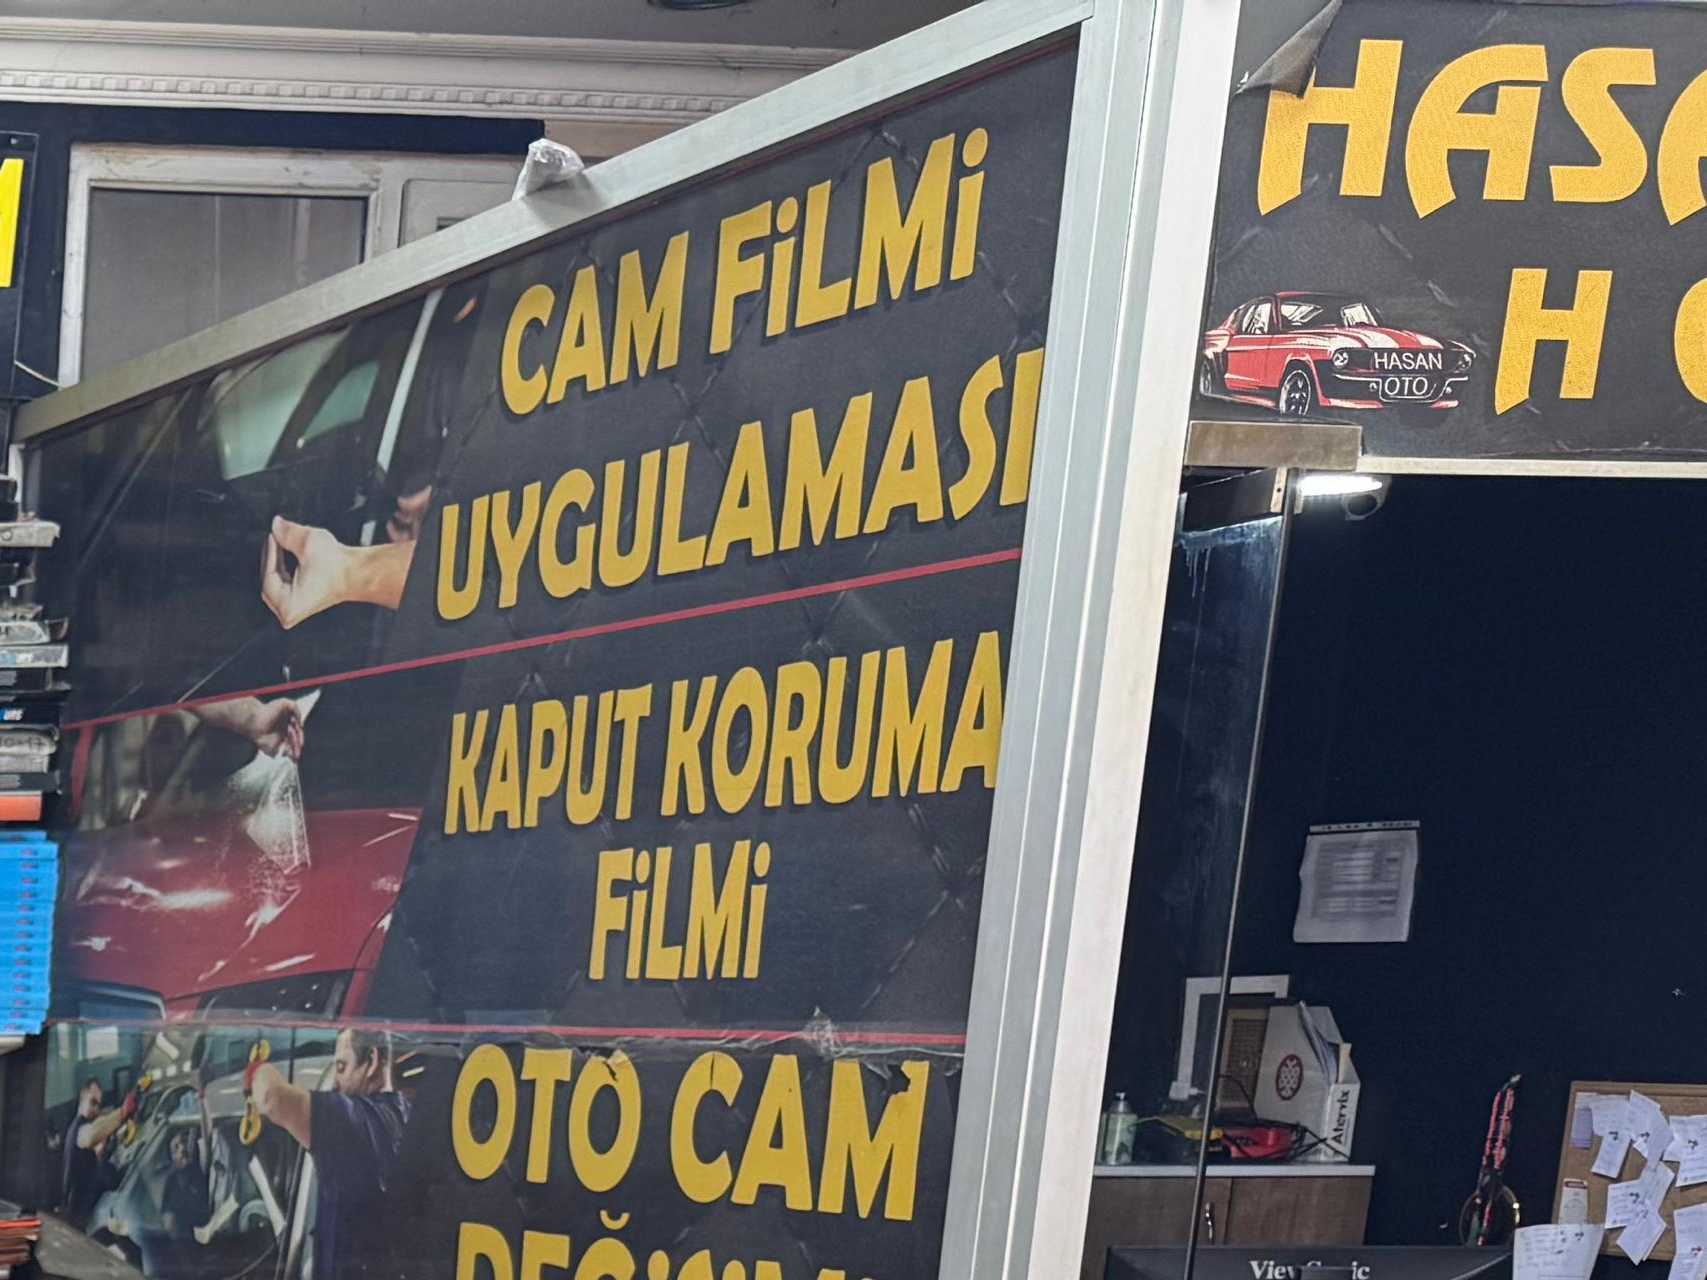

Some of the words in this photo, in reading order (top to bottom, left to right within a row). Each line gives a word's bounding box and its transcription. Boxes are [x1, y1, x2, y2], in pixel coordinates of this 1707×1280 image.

[500, 232, 688, 416] CAM
[1374, 351, 1443, 372] HASAN
[1384, 376, 1428, 396] OTO
[444, 682, 655, 834] KAPUT
[660, 630, 1002, 815] KORUMA
[451, 1044, 642, 1192] OTO
[669, 1050, 931, 1222] CAM
